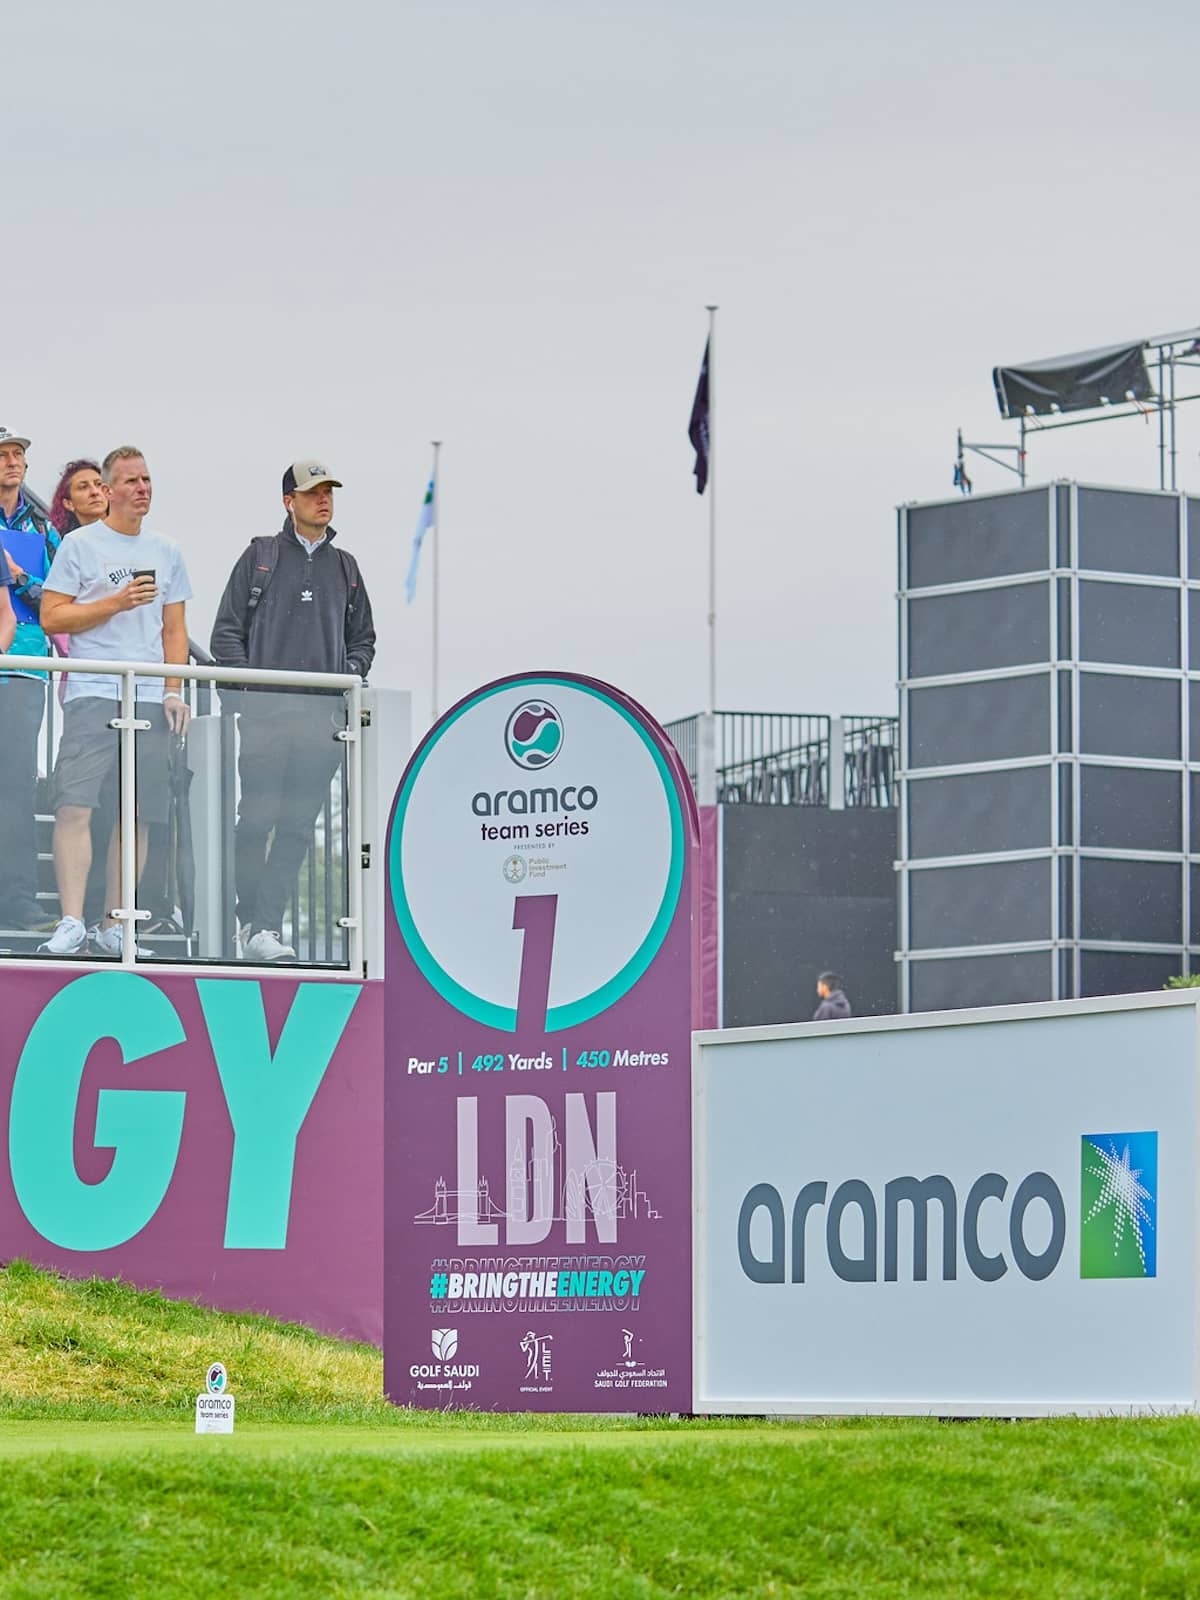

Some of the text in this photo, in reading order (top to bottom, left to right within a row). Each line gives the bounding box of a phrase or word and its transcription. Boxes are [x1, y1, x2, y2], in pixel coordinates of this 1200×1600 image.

[471, 785, 599, 817] aramco
[480, 815, 590, 841] team series
[511, 894, 559, 1033] 1
[407, 1049, 670, 1075] Par 5 492 Yards 450 Metres
[456, 1091, 618, 1247] LDN
[738, 1171, 1066, 1284] aramco
[430, 1269, 646, 1299] #BRINGTHEENERGY
[409, 1364, 480, 1377] GOLF SAUDI
[594, 1380, 668, 1388] SAUDI GOLF FEDERATION
[198, 1399, 232, 1410] aramco
